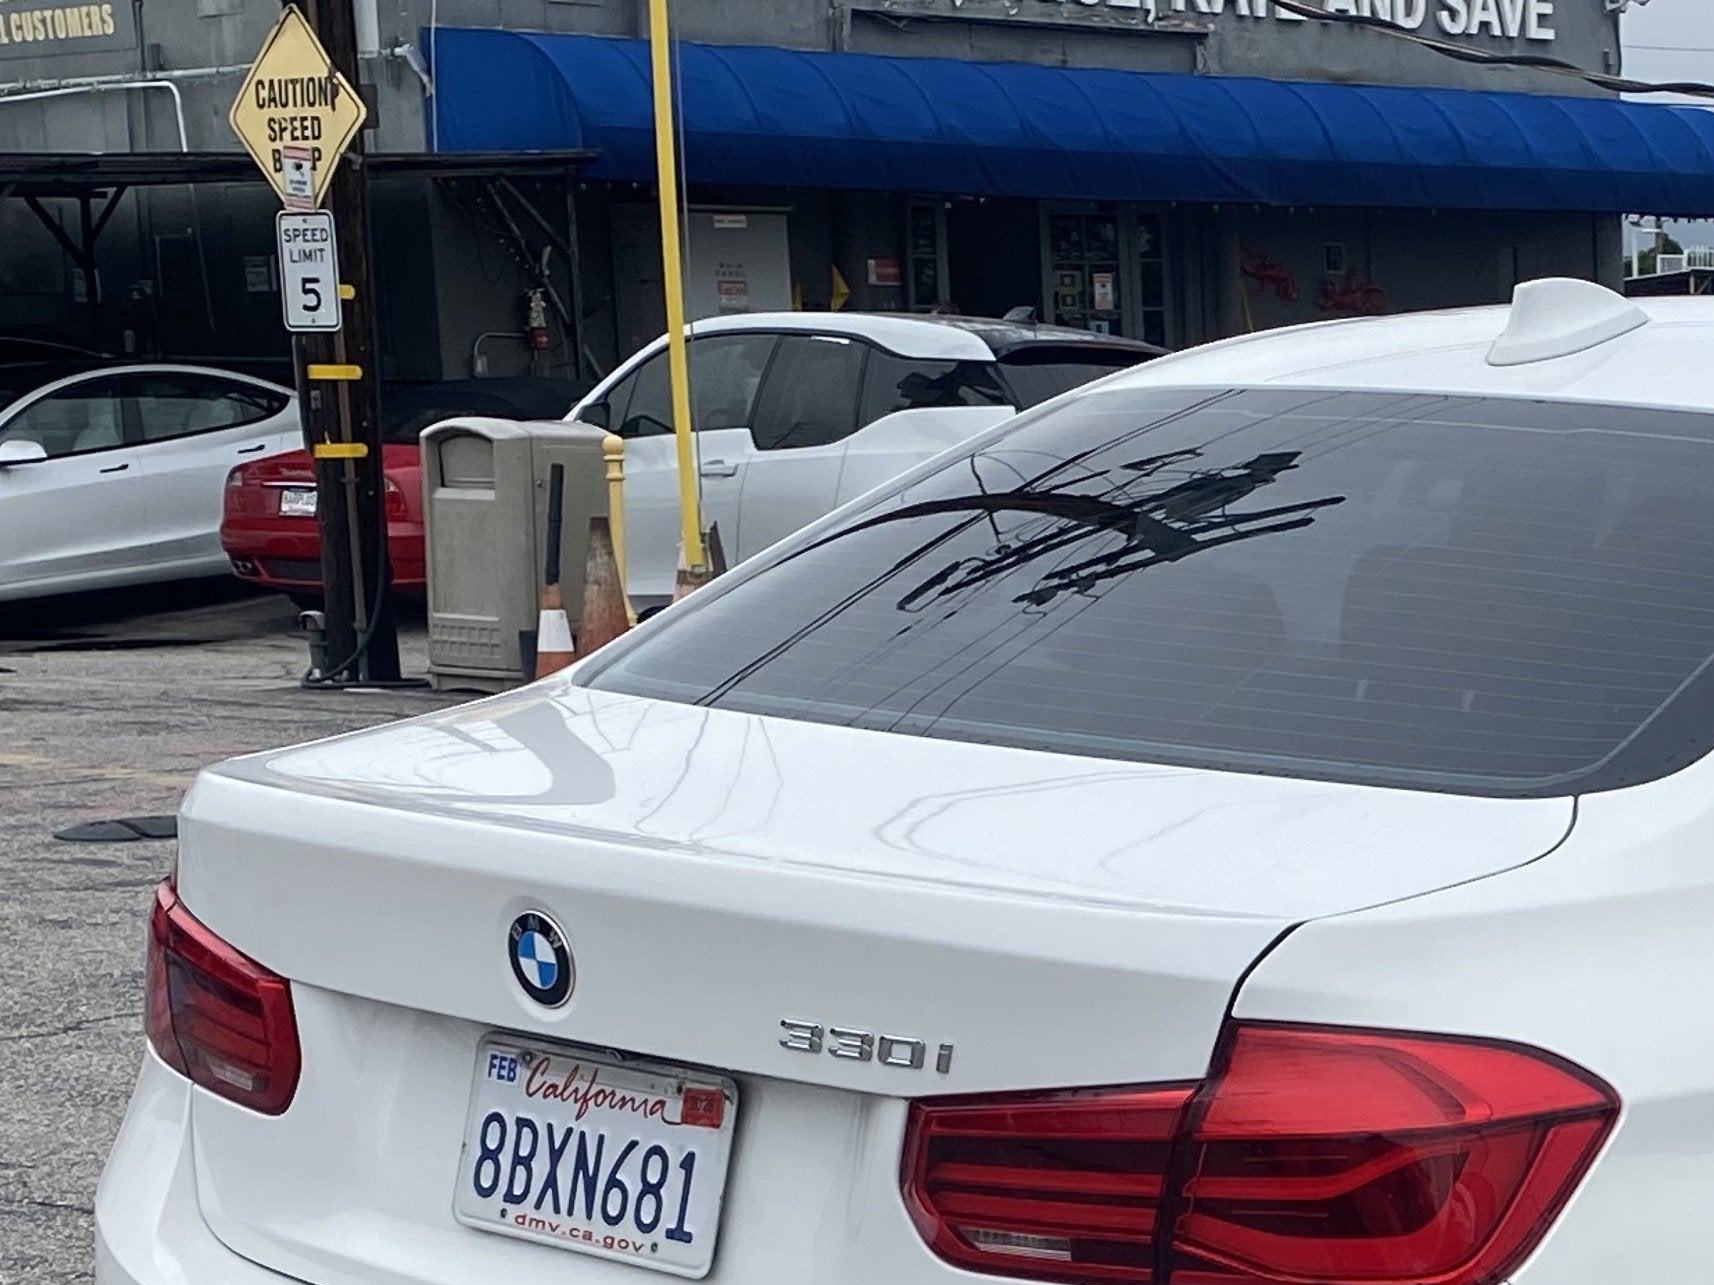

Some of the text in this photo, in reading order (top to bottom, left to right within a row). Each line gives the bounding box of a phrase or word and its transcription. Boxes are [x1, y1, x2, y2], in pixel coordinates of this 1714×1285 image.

[9, 3, 115, 43] CUSTOMERS
[1436, 0, 1556, 40] SAVE
[255, 75, 330, 109] CAUTION
[267, 115, 322, 142] SPEED
[272, 147, 322, 173] BP
[284, 227, 328, 243] SPEED
[289, 247, 325, 263] LIMIT
[301, 276, 322, 312] 5
[779, 1018, 954, 1074] 330i
[487, 1053, 682, 1125] FEB California
[473, 1111, 697, 1243] 8BXN681
[514, 1211, 645, 1253] dmv.ca.gov
